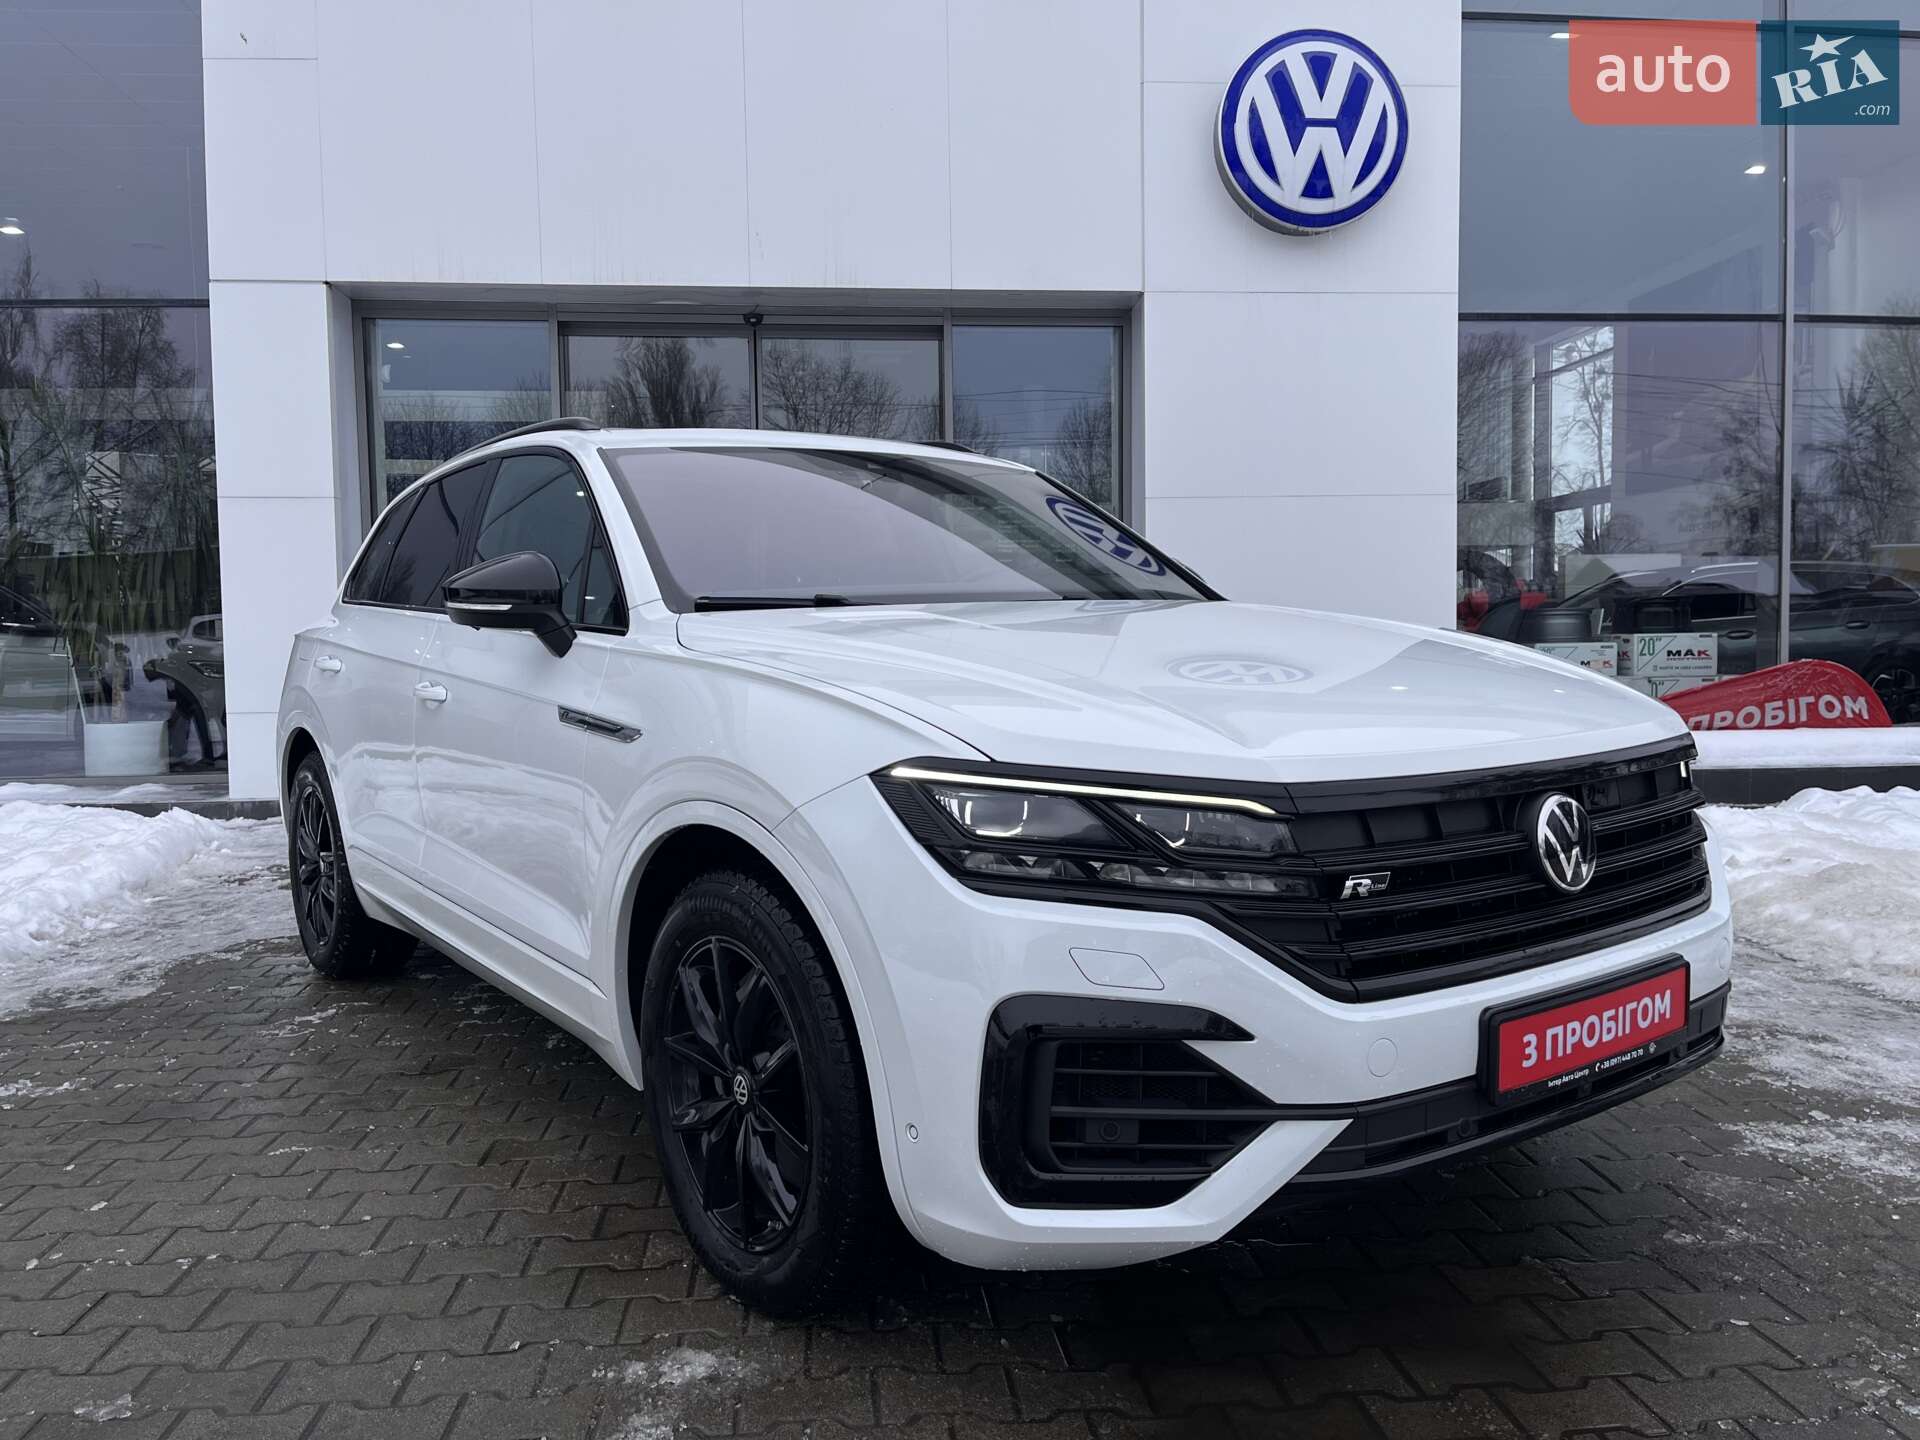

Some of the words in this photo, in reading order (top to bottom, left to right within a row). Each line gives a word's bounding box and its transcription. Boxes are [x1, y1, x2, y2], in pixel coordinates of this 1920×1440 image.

[1234, 40, 1399, 215] VW
[1580, 659, 1613, 667] MK
[1666, 648, 1710, 657] MAK
[1687, 694, 1869, 731] ПРОБІГОМ
[1546, 989, 1671, 1060] ПРОБІГОМ
